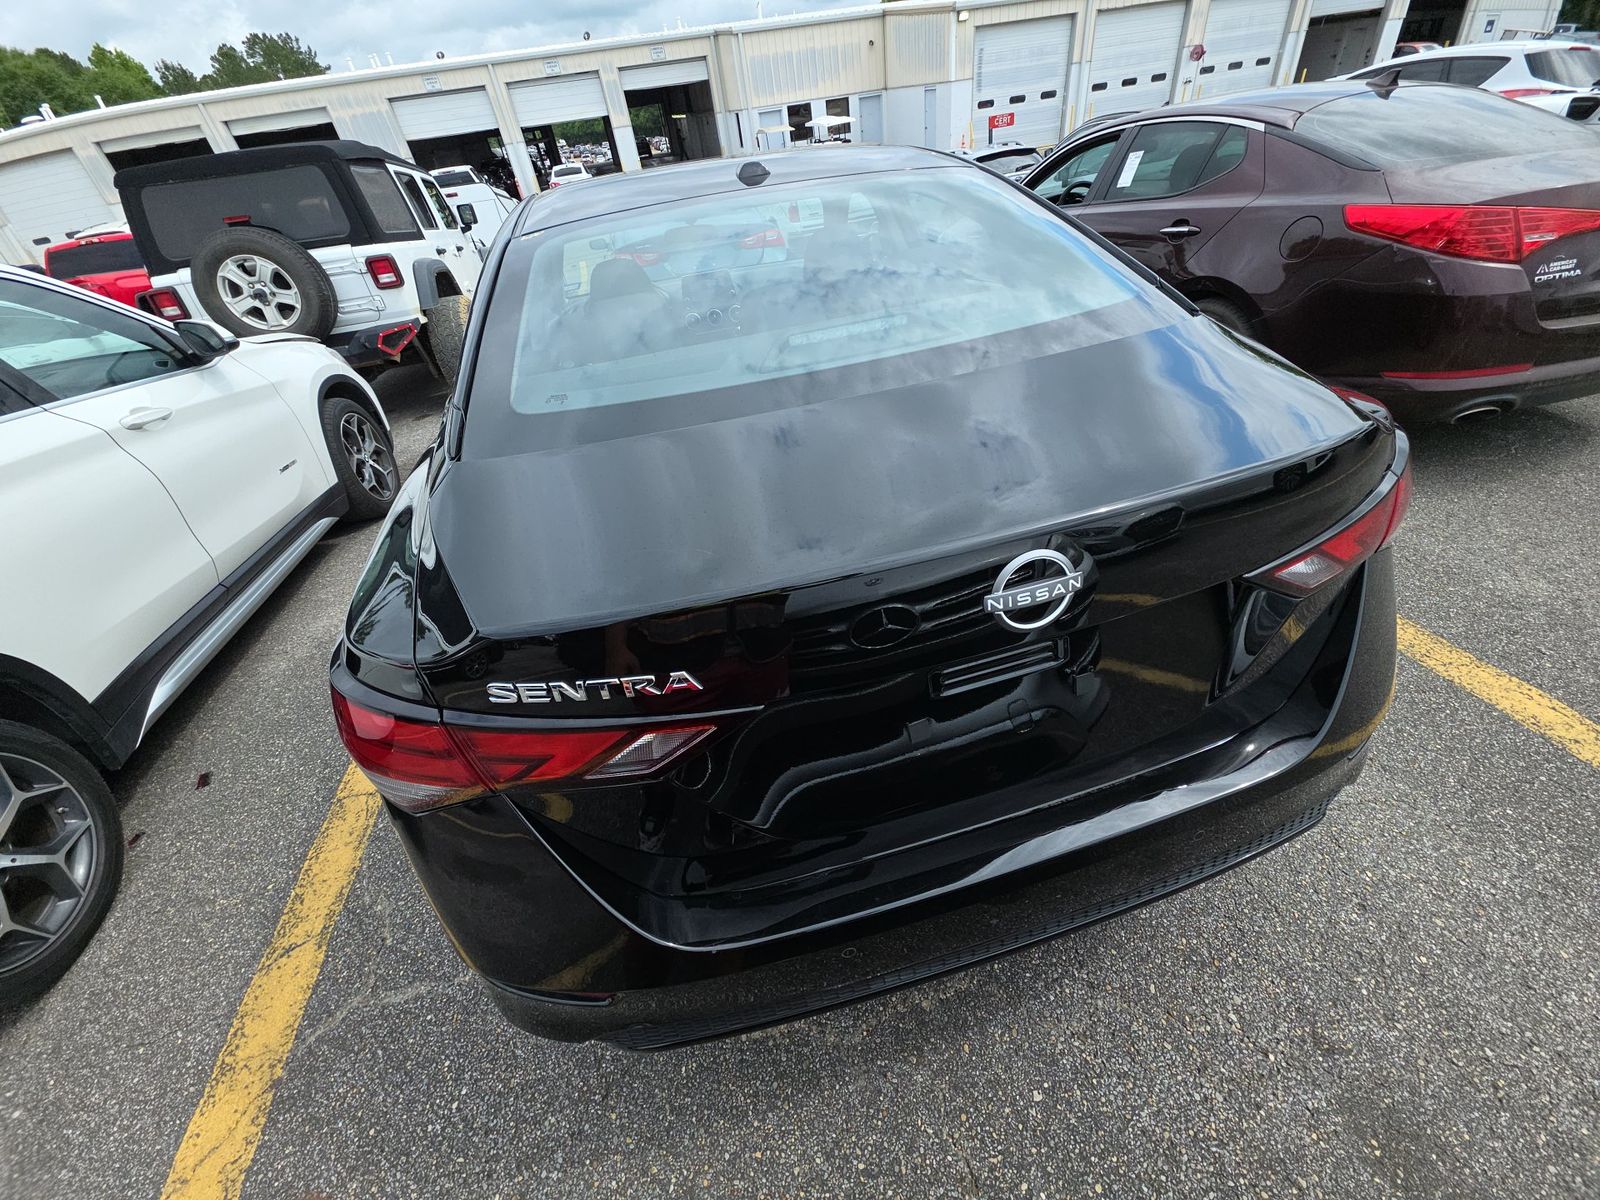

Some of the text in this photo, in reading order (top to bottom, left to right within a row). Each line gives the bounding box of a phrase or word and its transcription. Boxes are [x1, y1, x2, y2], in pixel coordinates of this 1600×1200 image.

[995, 115, 1011, 126] CERT
[1535, 269, 1581, 283] OPTIMA
[987, 576, 1081, 612] NISSAN
[486, 671, 704, 704] SENTRA
